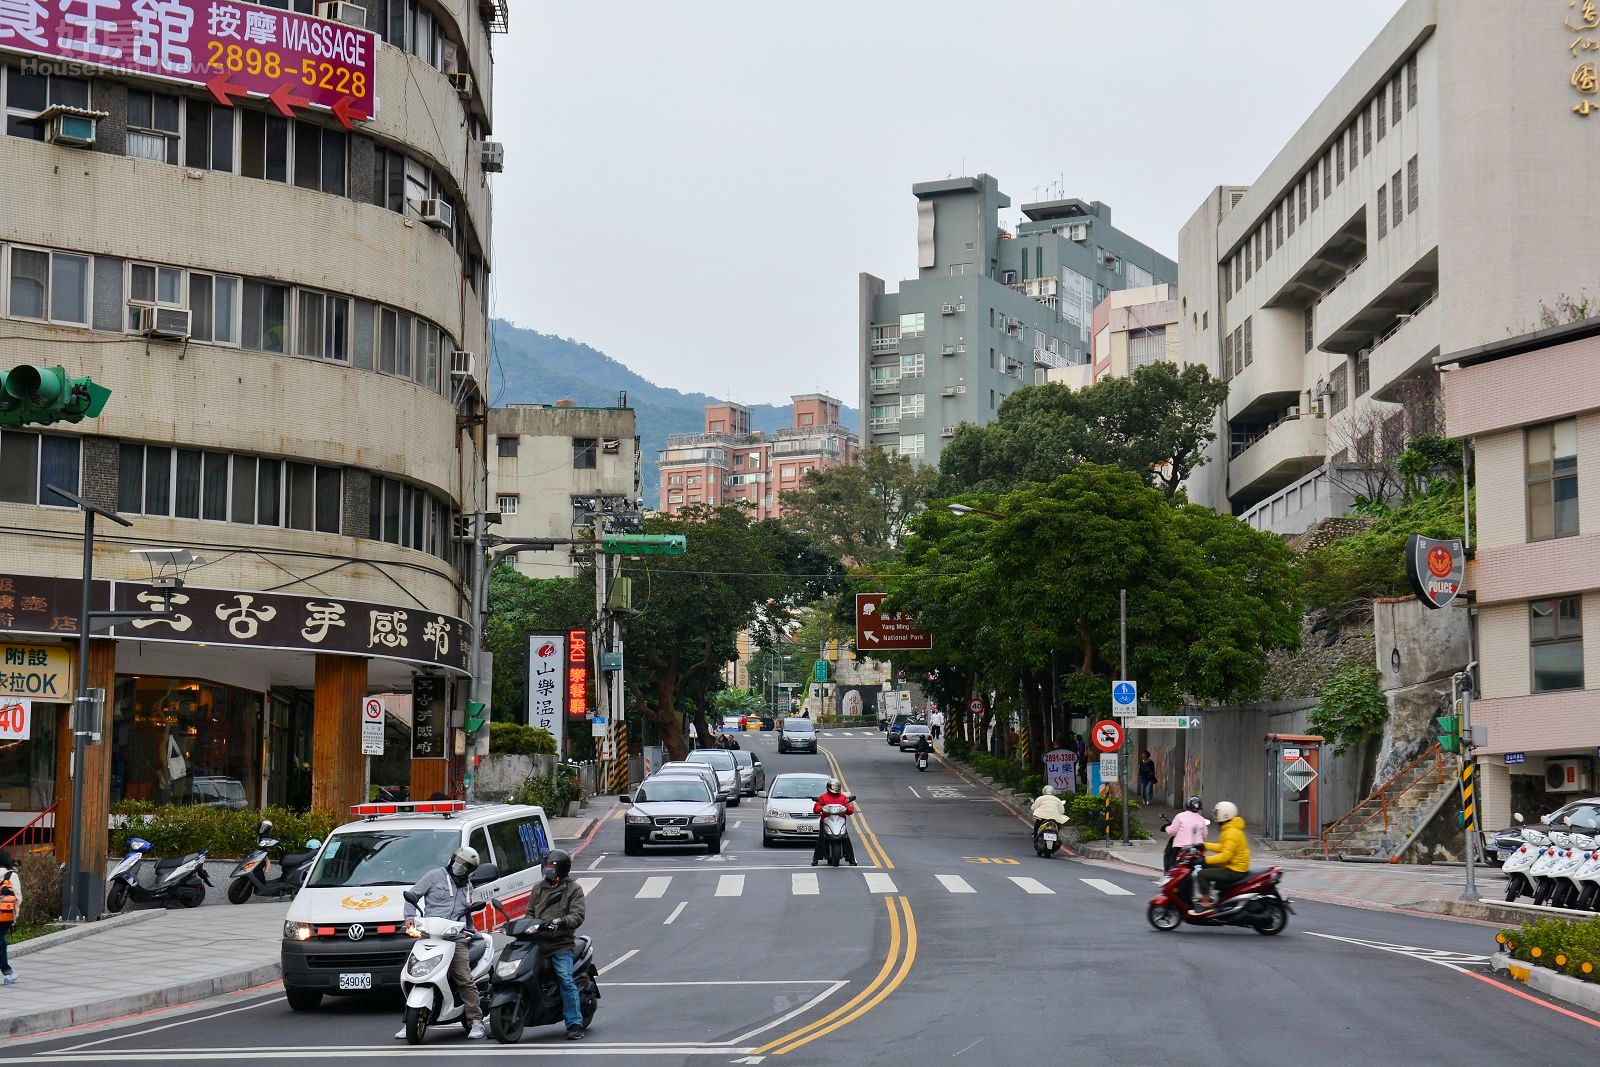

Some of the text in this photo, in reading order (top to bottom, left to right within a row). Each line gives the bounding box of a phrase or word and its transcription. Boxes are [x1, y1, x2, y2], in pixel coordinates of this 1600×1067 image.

[208, 2, 366, 67] 按摩 MASSAGE
[207, 41, 367, 98] 2898-5228
[1428, 580, 1453, 593] POLICE
[896, 623, 910, 631] Ming
[5, 647, 48, 667] 附設
[570, 630, 586, 662] LAKU
